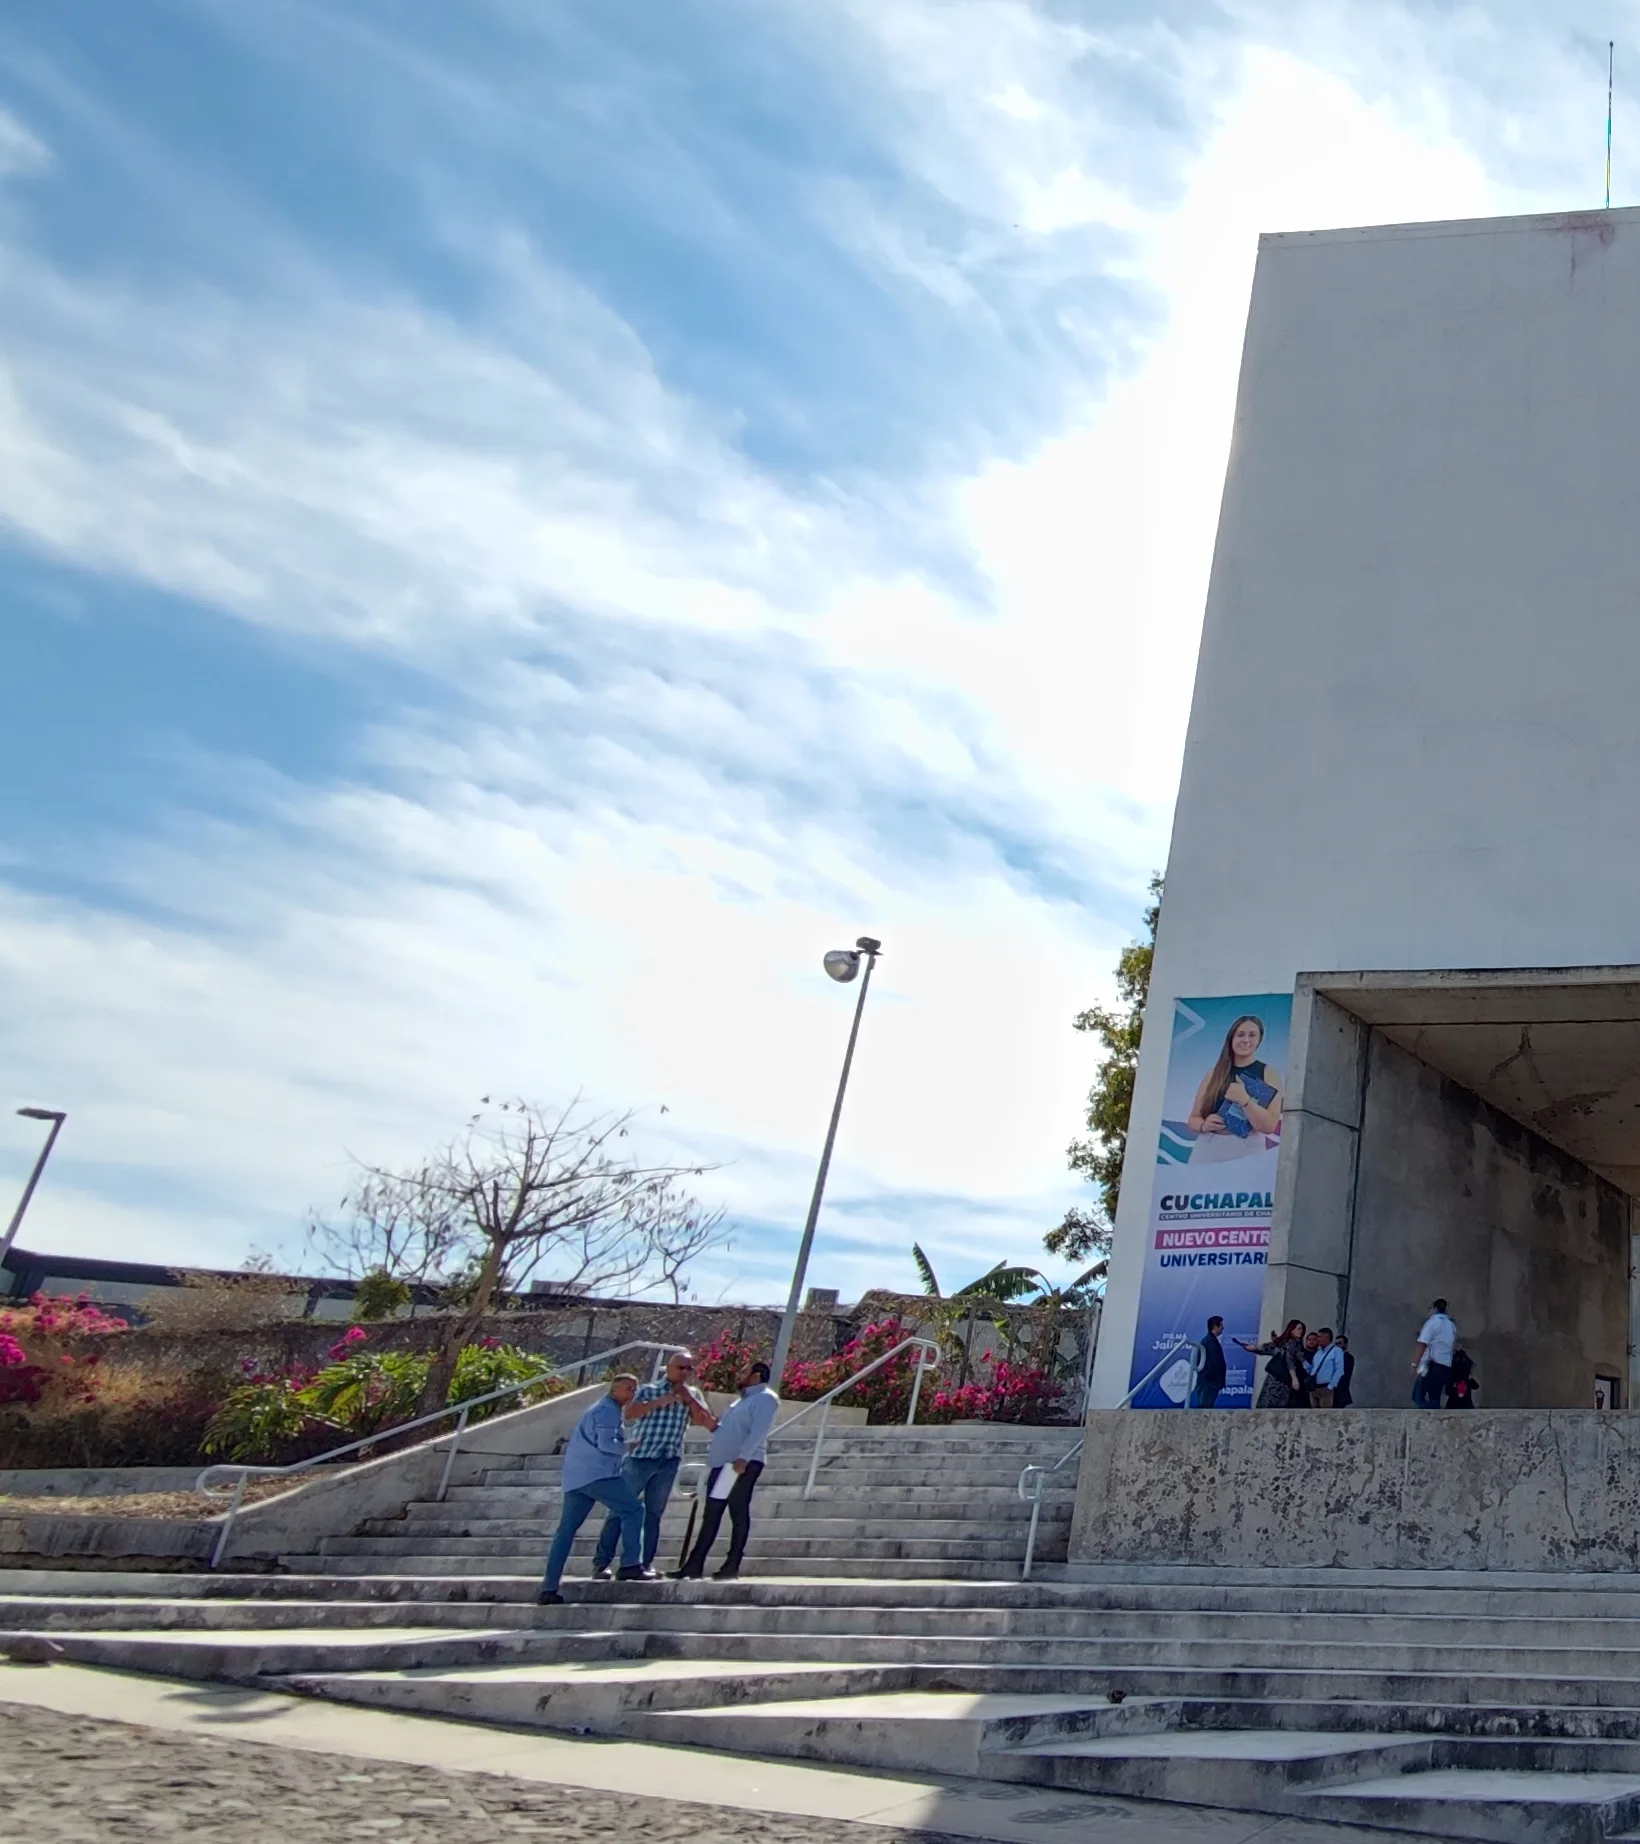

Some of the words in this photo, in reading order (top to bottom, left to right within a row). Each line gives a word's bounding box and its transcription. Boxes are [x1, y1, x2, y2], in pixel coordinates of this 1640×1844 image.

[1160, 1192, 1273, 1211] CUCHAPAL
[1189, 1211, 1243, 1219] UNIVERSITARIO
[1162, 1231, 1215, 1246] NUEVO
[1218, 1230, 1270, 1245] CENTR
[1160, 1251, 1268, 1267] UNIVERSITARI
